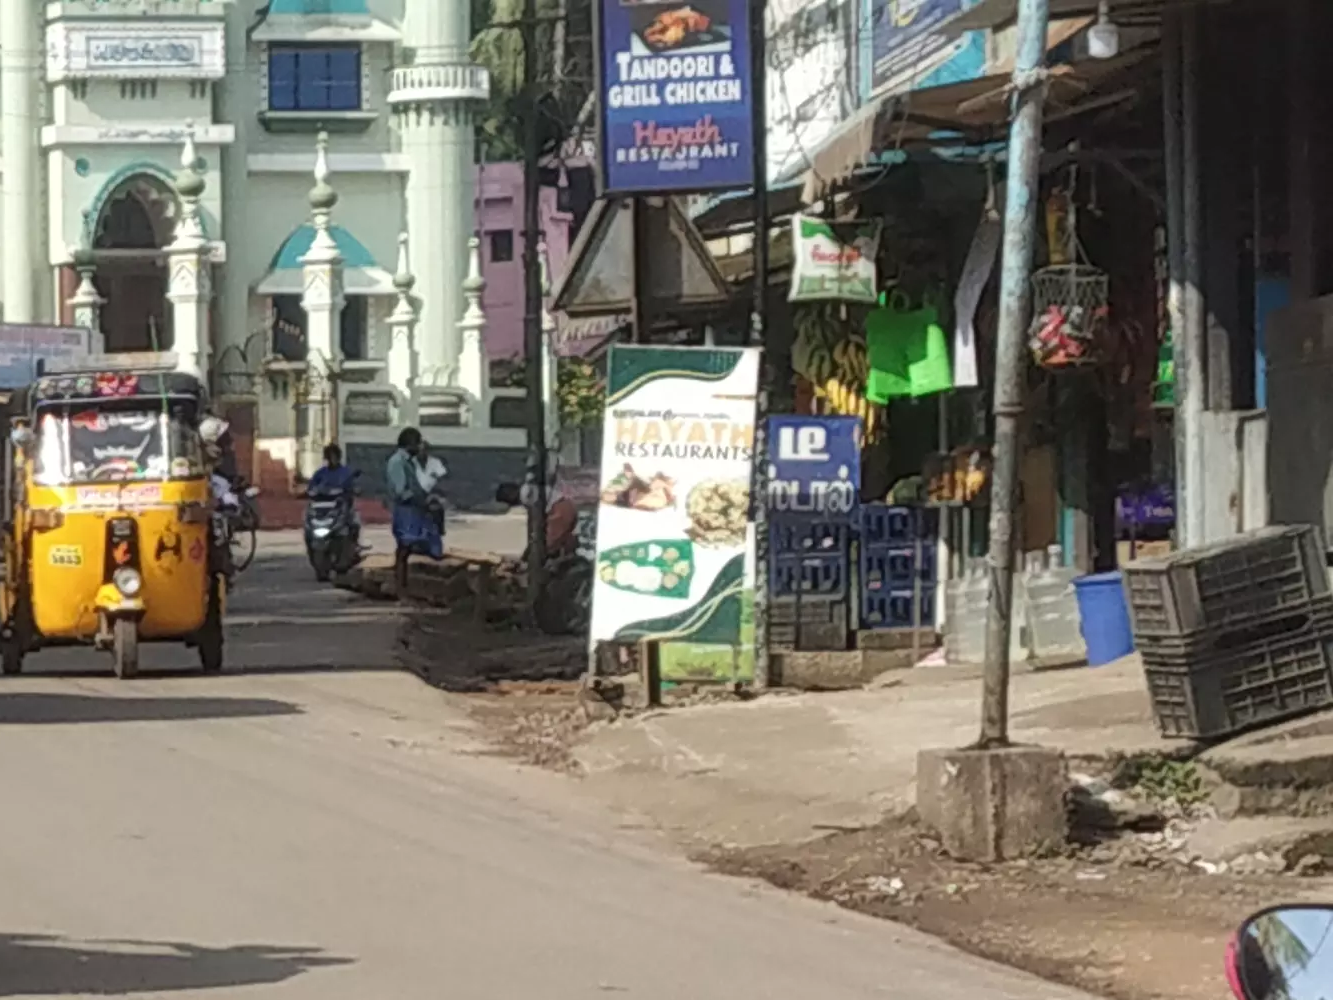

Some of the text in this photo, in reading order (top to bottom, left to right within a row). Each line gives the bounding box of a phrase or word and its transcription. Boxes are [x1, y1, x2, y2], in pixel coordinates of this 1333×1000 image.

[616, 52, 735, 82] TANDOORI &
[608, 79, 741, 108] GRILL CHICKEN
[633, 114, 721, 152] Hayath
[616, 142, 739, 163] RESTAURANT
[616, 418, 754, 447] HAYATH
[614, 442, 755, 462] RESTAURANTS
